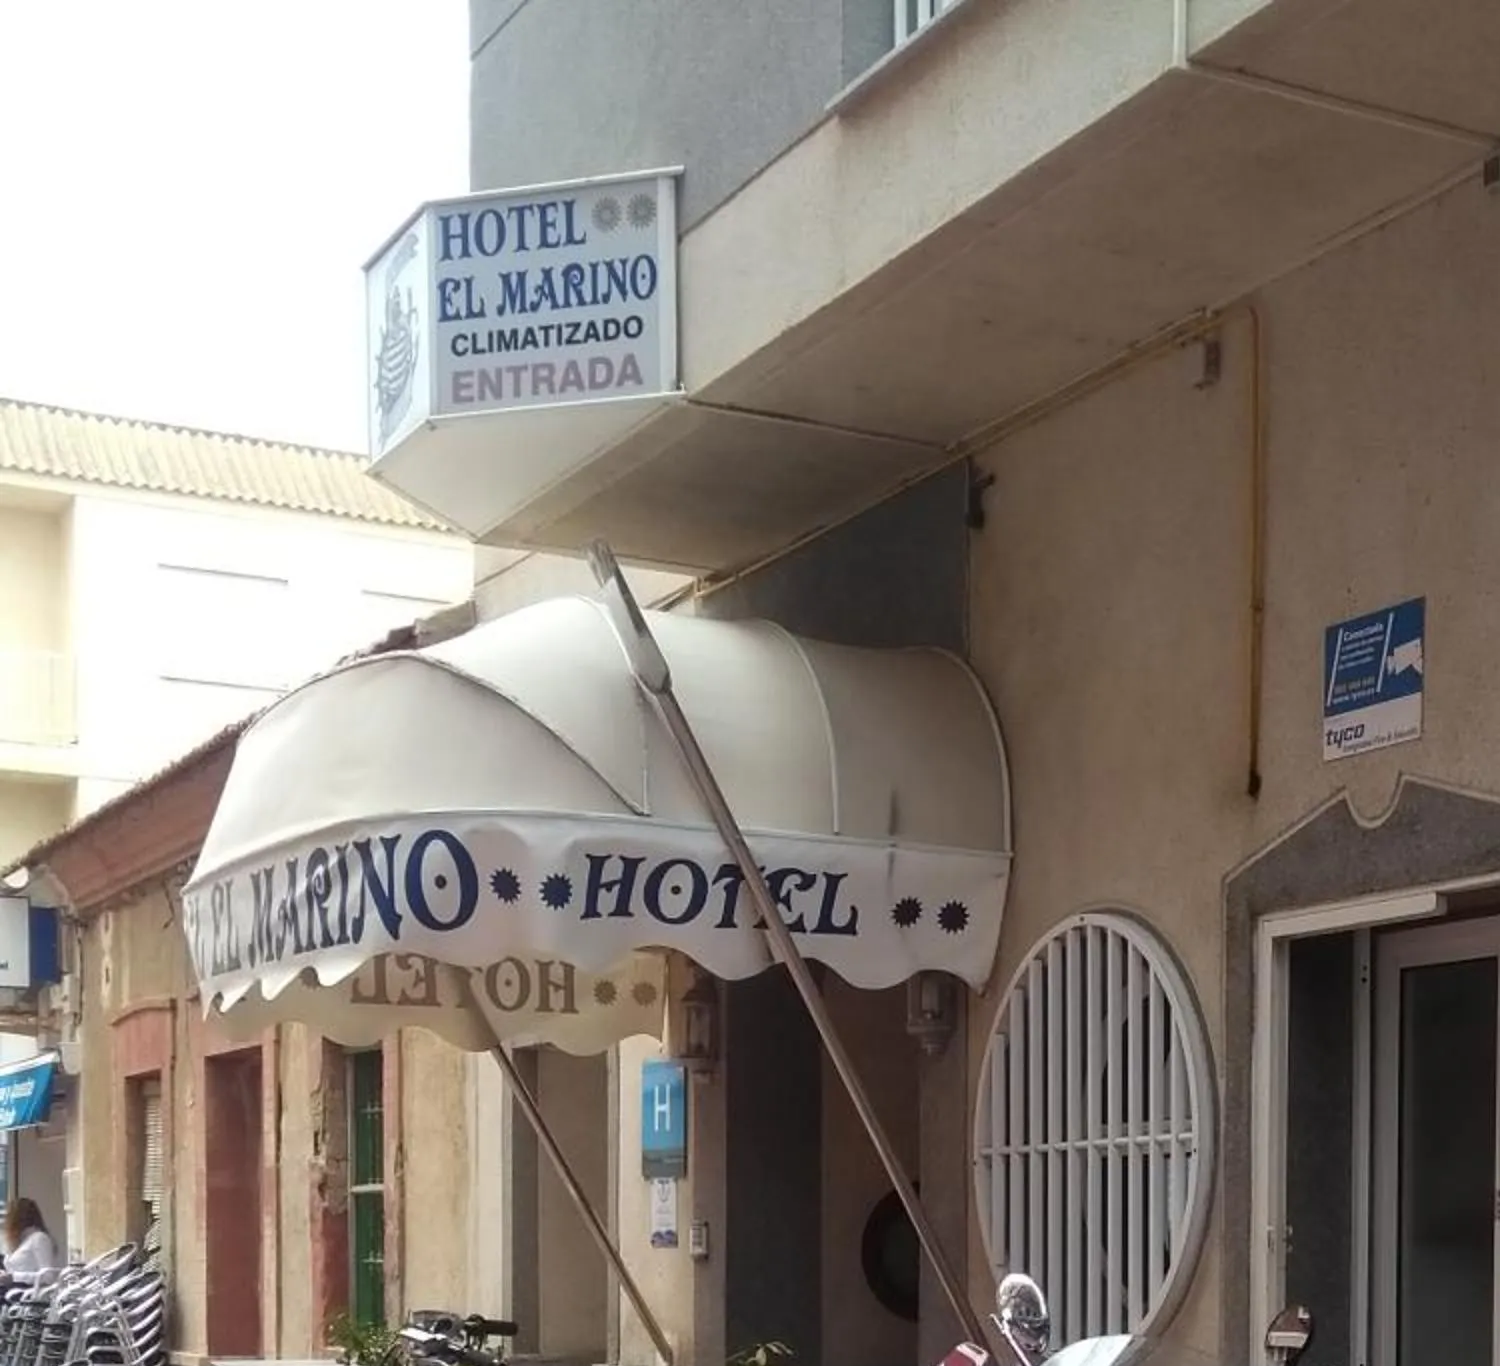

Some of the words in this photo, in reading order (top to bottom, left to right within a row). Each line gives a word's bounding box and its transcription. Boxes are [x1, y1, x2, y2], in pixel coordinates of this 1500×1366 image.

[438, 199, 587, 262] HOTEL
[436, 274, 486, 322] EL
[496, 254, 657, 316] MARINO
[451, 315, 644, 357] CLIMATIZADO
[452, 353, 643, 404] ENTRADA
[1325, 723, 1365, 748] tyco
[211, 878, 241, 976] EL
[248, 829, 479, 968] MARINO
[580, 853, 859, 936] HOTEL
[654, 1083, 671, 1132] H
